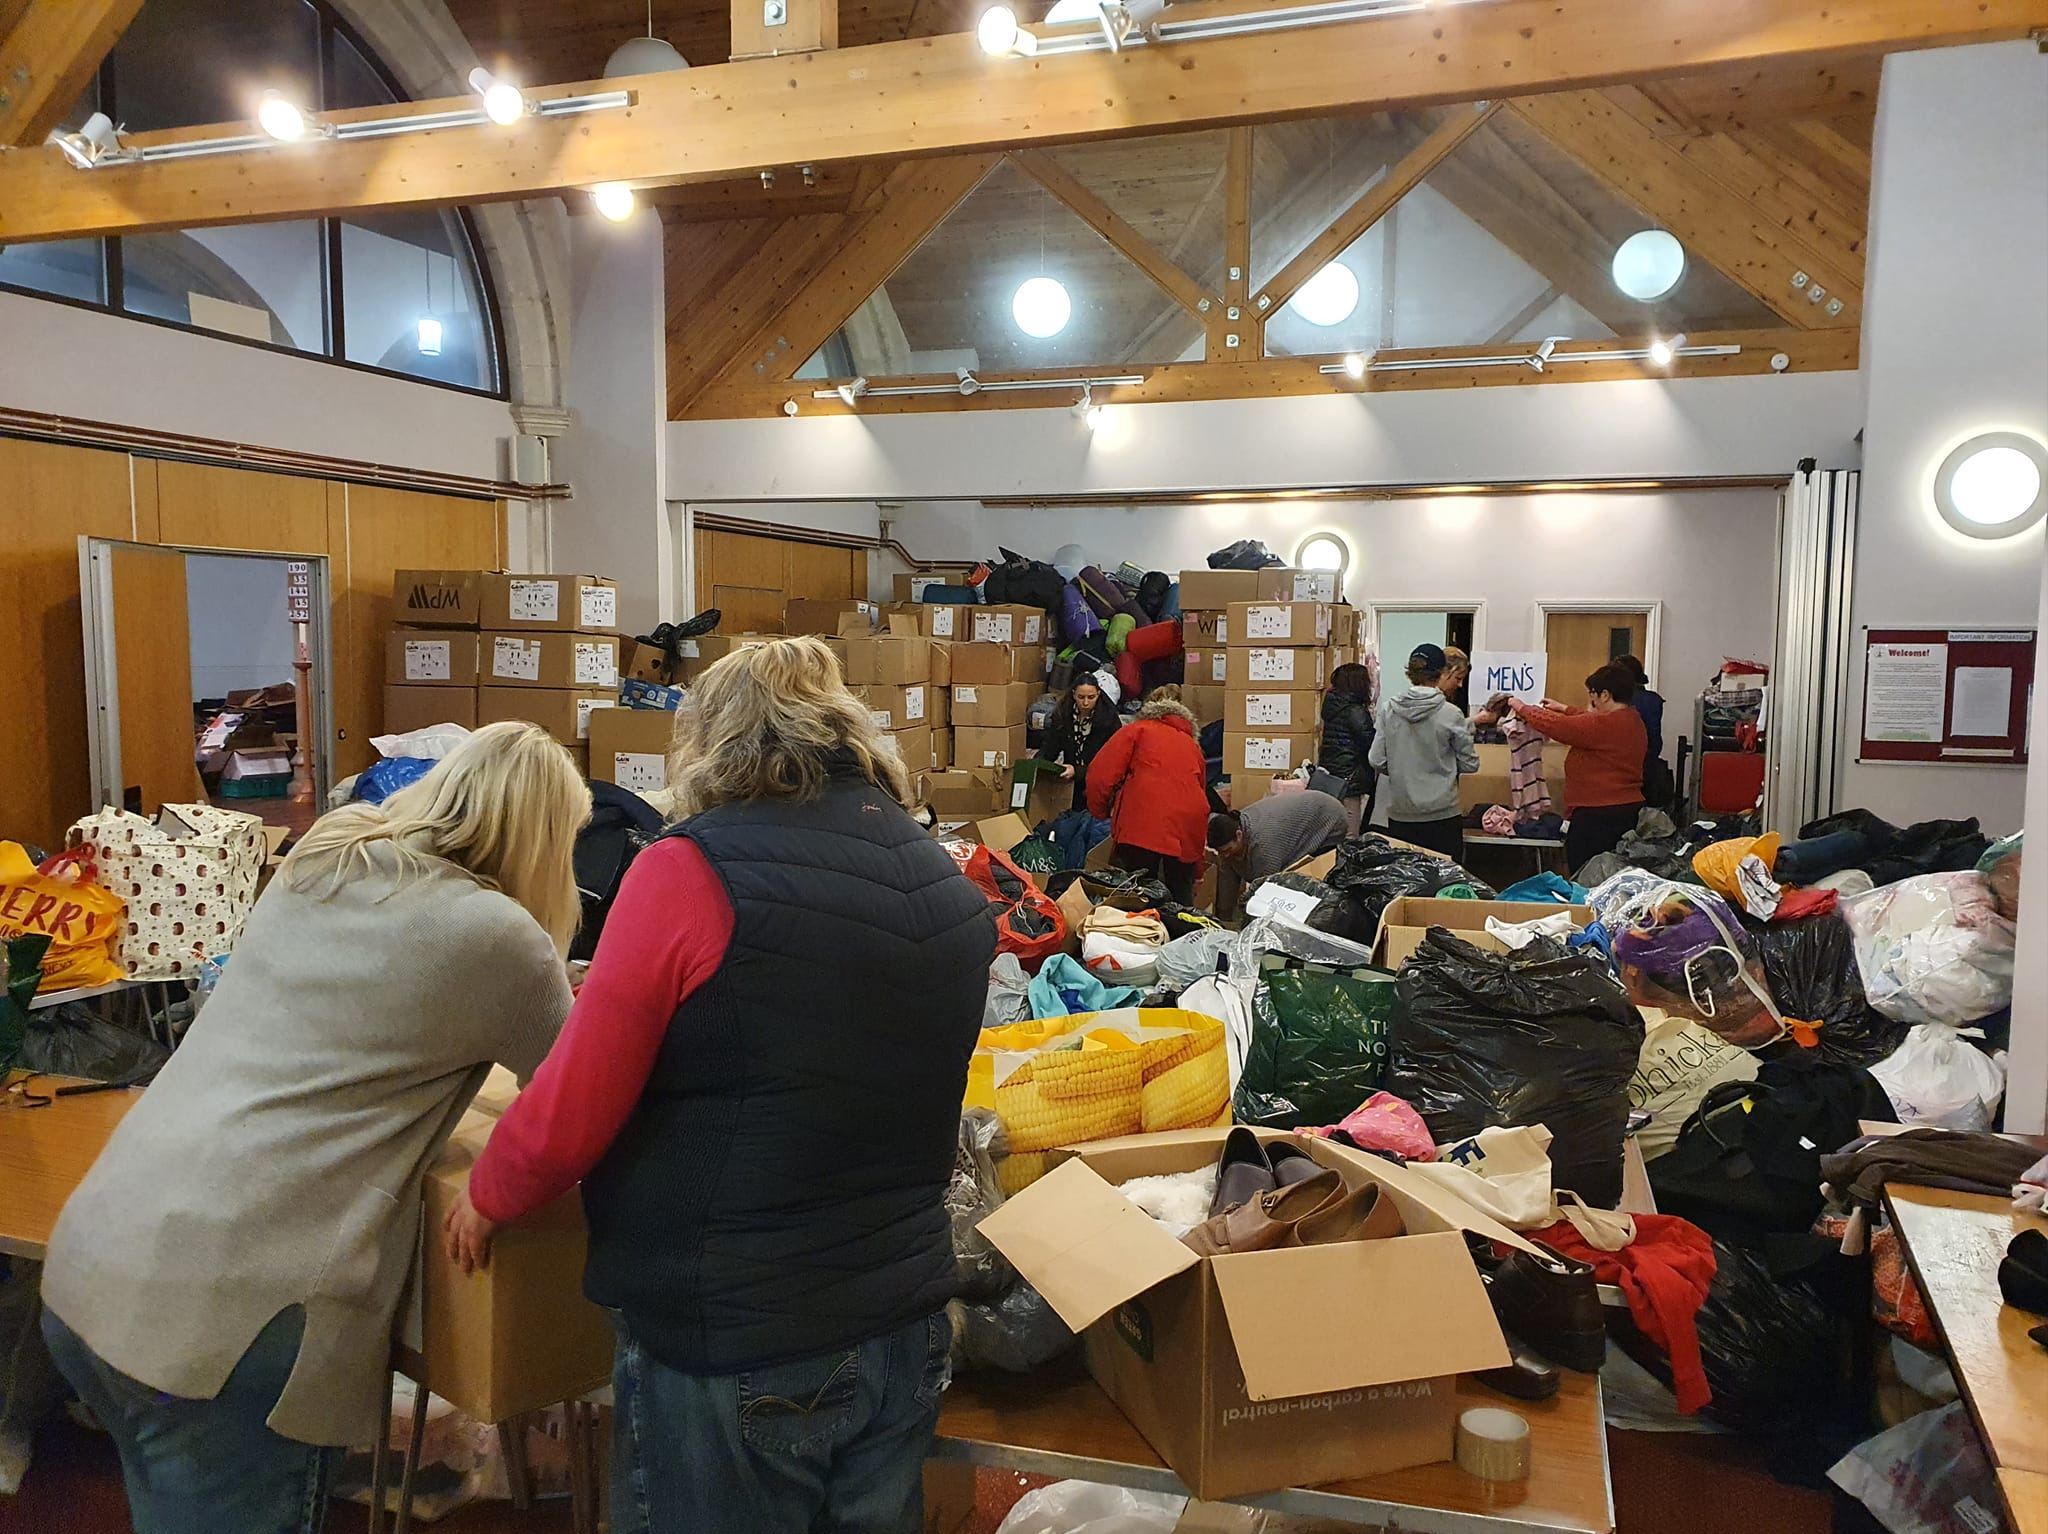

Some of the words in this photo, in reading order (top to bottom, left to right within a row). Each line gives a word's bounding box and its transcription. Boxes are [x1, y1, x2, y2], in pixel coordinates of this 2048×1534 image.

[1888, 649, 1930, 657] Welcome!
[1487, 663, 1535, 691] MEN'S
[1022, 856, 1057, 872] M&S
[0, 885, 96, 941] ERR
[1367, 1389, 1379, 1399] a
[1383, 1381, 1433, 1399] We're
[1223, 1392, 1362, 1426] carbon-neutral
